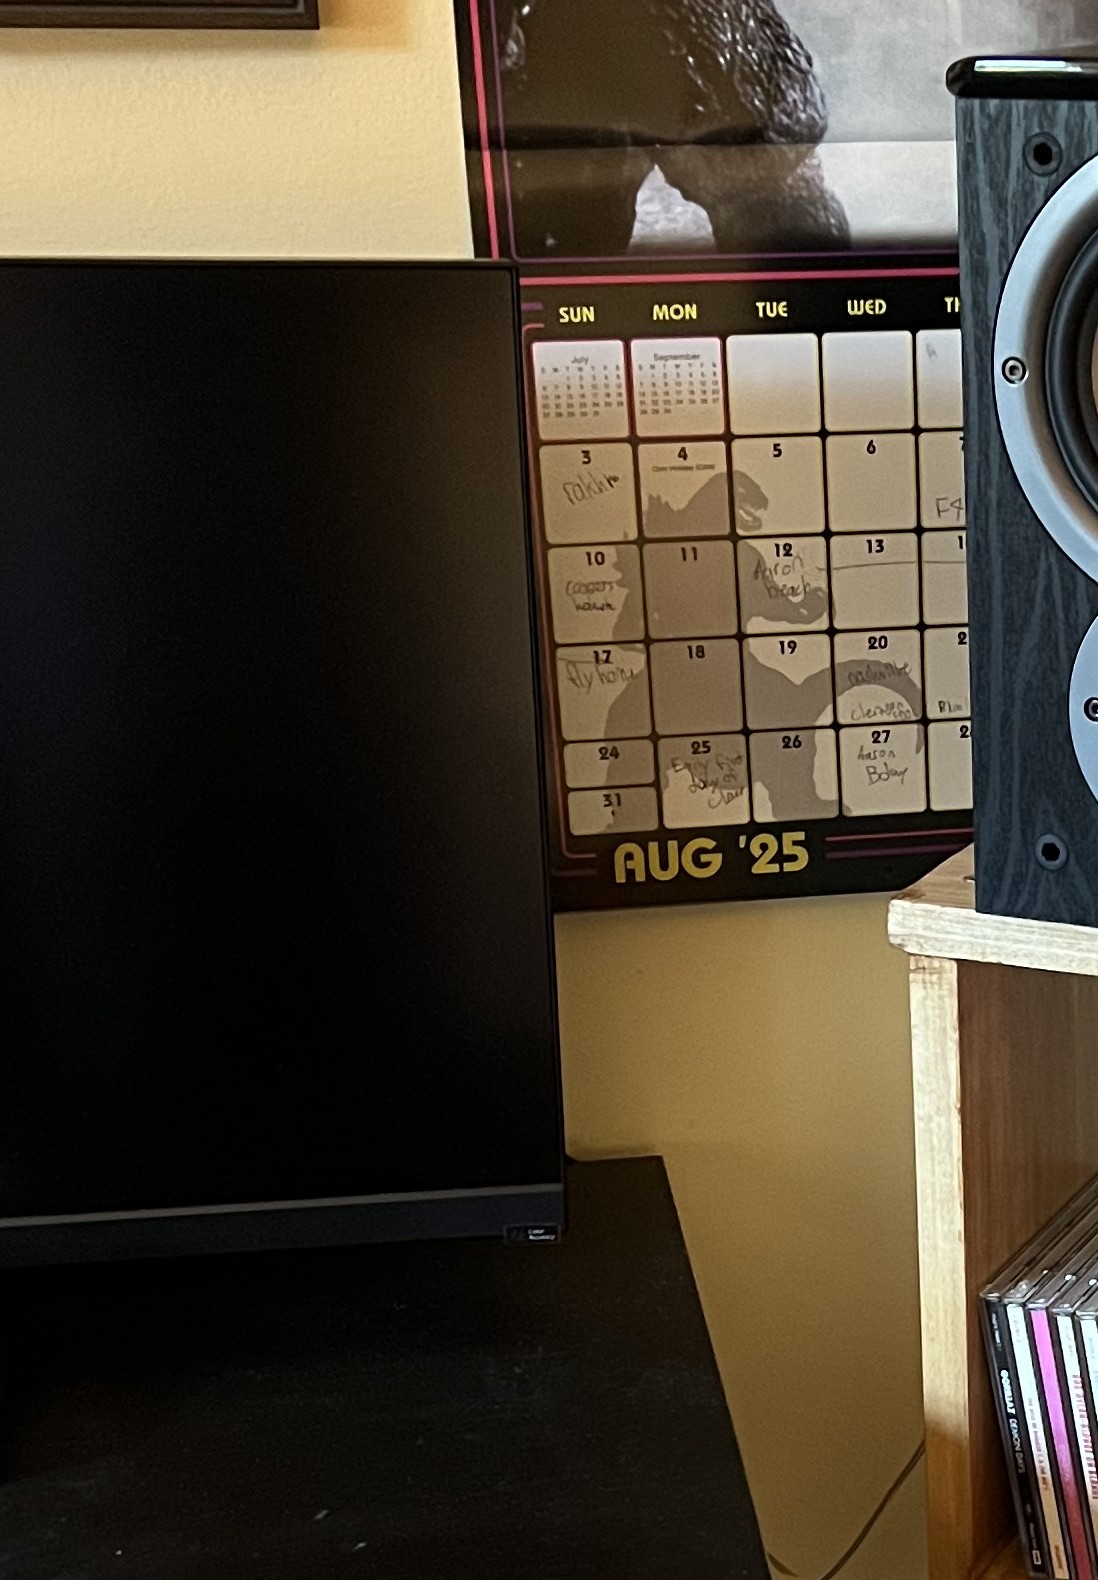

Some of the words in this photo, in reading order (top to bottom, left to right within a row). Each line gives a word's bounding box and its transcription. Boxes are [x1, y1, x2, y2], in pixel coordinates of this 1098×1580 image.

[558, 306, 595, 323] SUN
[652, 303, 698, 321] MON
[756, 301, 788, 318] TUE
[846, 299, 887, 315] WED
[677, 446, 688, 460] 4
[772, 443, 783, 458] 5
[866, 440, 876, 455] 6
[582, 450, 592, 464] 3
[774, 542, 793, 557] 12
[866, 539, 884, 554] 13
[957, 535, 964, 550] 1
[585, 551, 606, 566] 10
[681, 547, 698, 562] 11
[867, 635, 889, 650] 20
[957, 631, 968, 645] 2
[687, 644, 706, 659] 18
[778, 639, 798, 655] 19
[593, 650, 612, 664] 17
[871, 730, 891, 744] 27
[959, 724, 970, 739] 2
[690, 740, 712, 755] 25
[781, 735, 801, 750] 26
[598, 746, 619, 761] 24
[602, 793, 622, 809] 31
[613, 837, 723, 885] AUG
[738, 831, 810, 875] '25
